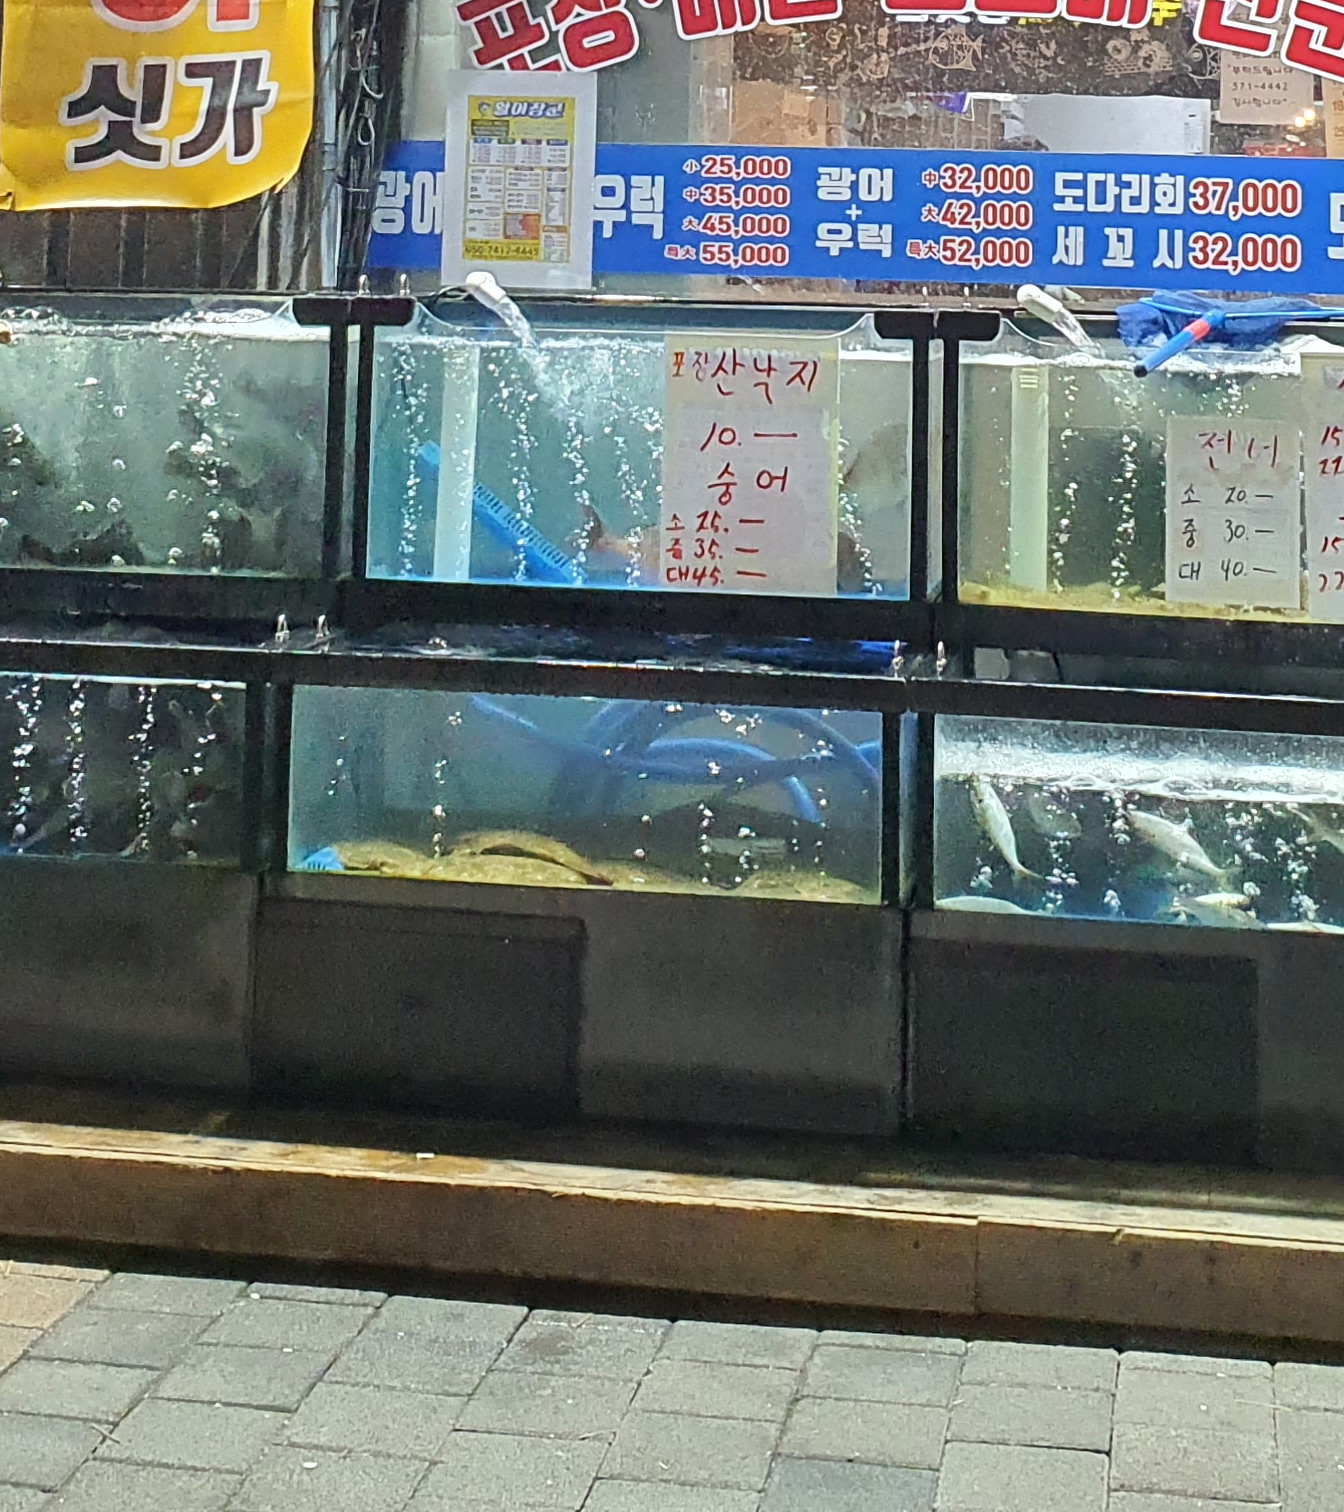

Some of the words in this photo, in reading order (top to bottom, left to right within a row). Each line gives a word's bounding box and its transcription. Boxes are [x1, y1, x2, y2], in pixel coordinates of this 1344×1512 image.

[1232, 81, 1288, 92] 571-4442
[1332, 99, 1344, 111] 18
[59, 50, 278, 170] 싯가
[816, 166, 893, 202] 광어
[1053, 171, 1185, 215] 도다리회
[1188, 176, 1302, 221] 37,000
[592, 174, 665, 240] 우럭
[815, 222, 893, 258] 우럭
[1188, 231, 1302, 275] 32,000
